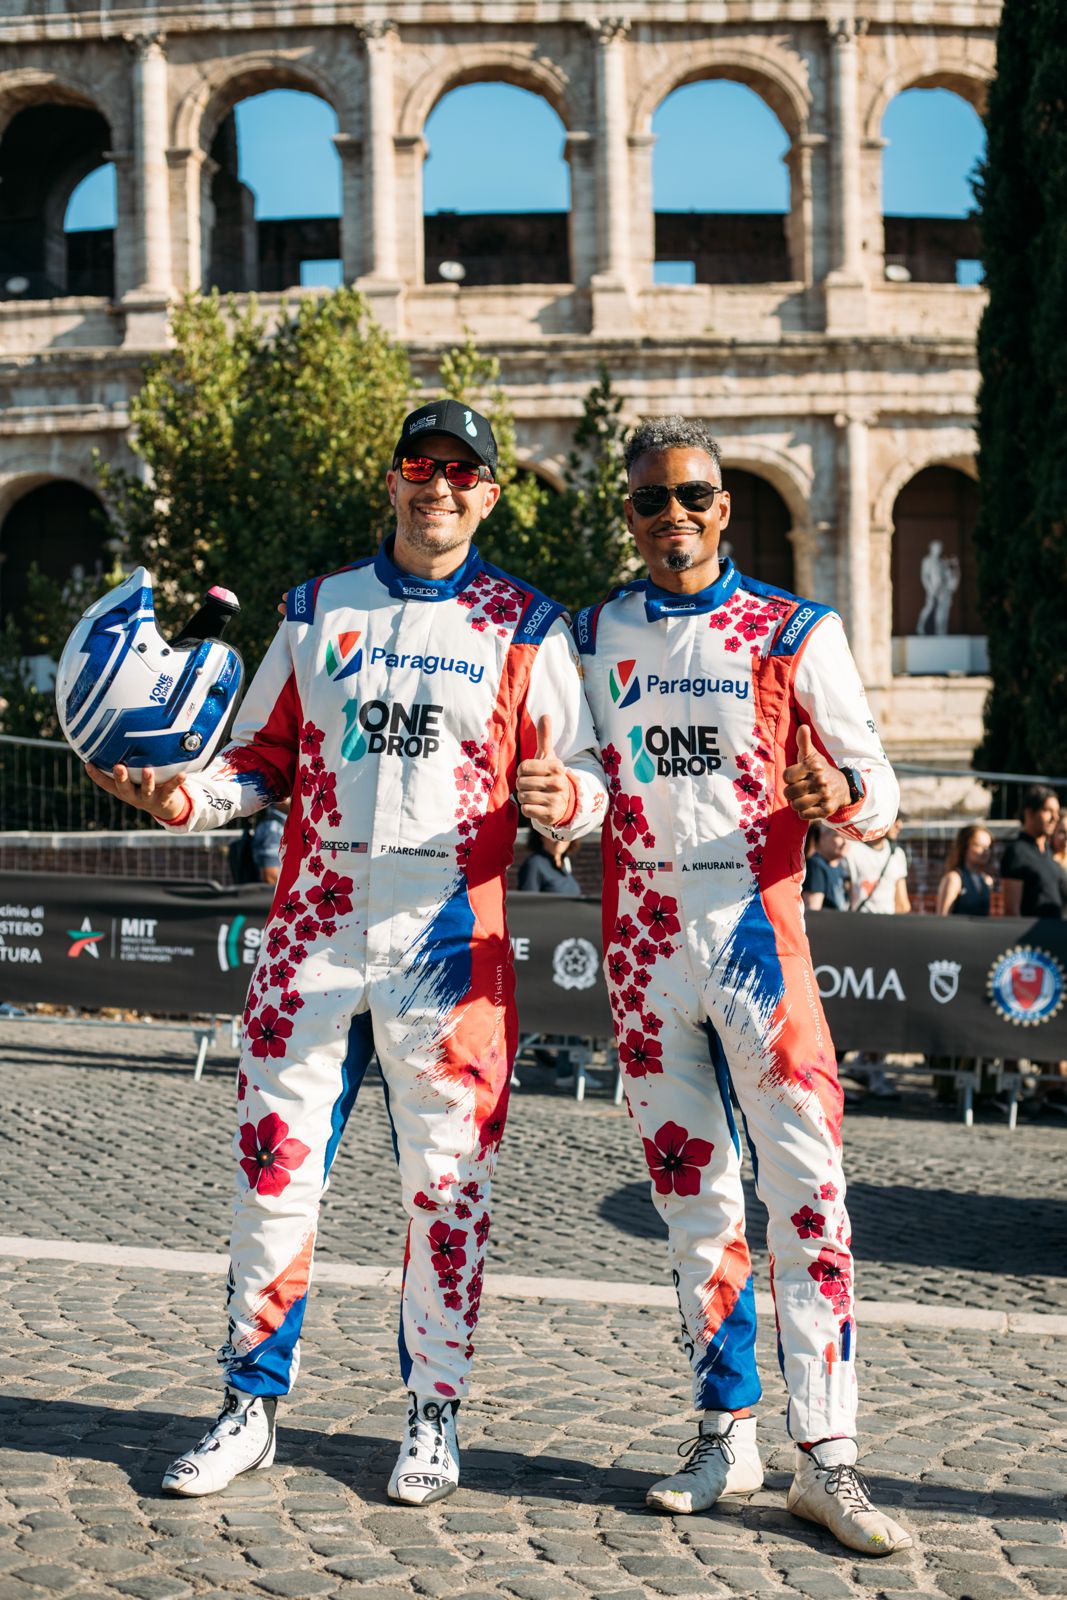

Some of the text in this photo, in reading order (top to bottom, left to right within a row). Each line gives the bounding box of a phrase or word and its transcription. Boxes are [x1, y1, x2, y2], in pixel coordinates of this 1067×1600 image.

[523, 601, 553, 637] sparco
[782, 607, 816, 647] sparco
[370, 647, 485, 684] Paraguay
[153, 672, 170, 698] ONE
[161, 676, 175, 698] DROP
[647, 675, 749, 700] Paraguay
[359, 699, 443, 738] ONE
[367, 733, 440, 759] DROP
[645, 725, 721, 757] ONE
[388, 845, 436, 858] MARCHINO
[681, 864, 691, 872] A.
[692, 860, 735, 871] KIHURANI
[121, 917, 158, 937] MIT
